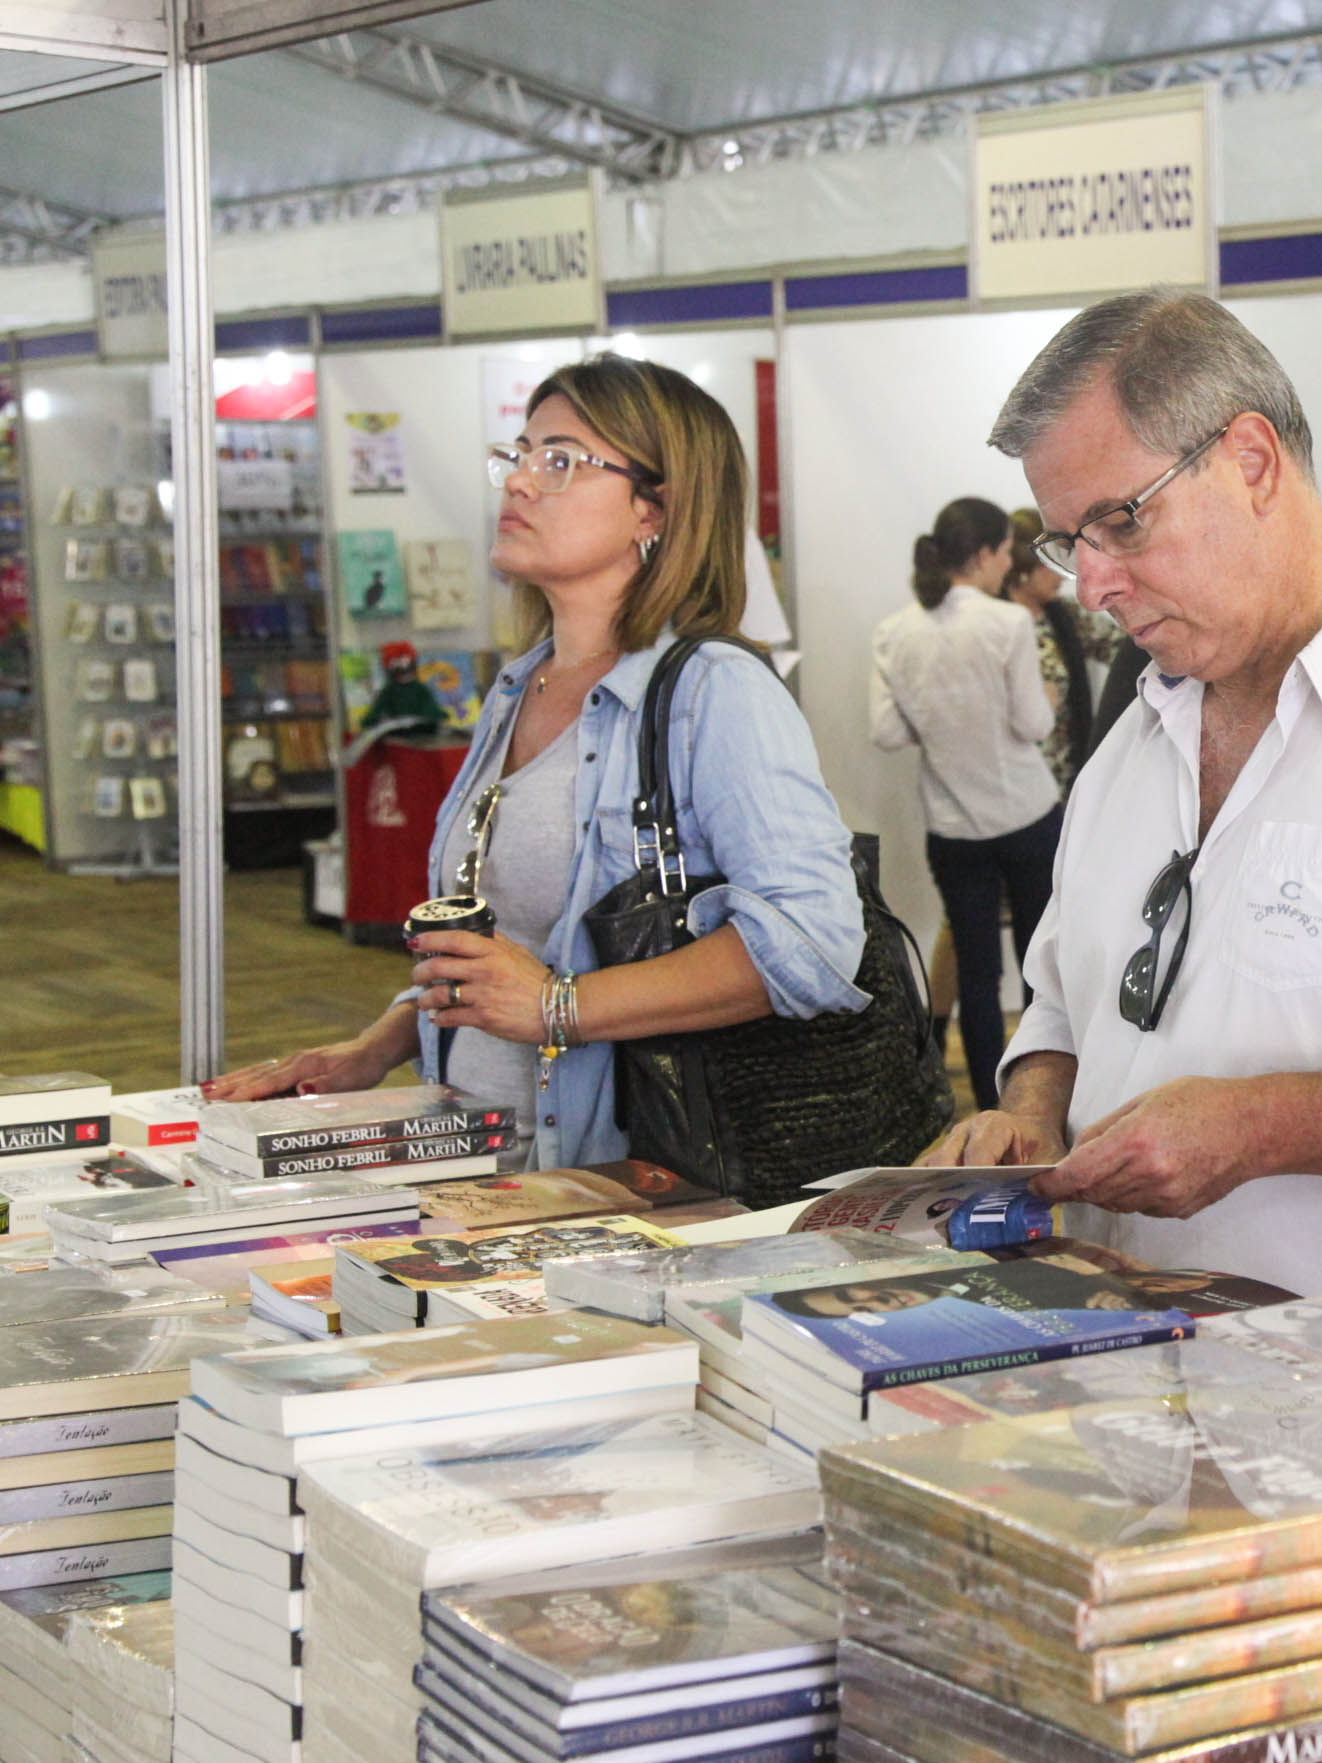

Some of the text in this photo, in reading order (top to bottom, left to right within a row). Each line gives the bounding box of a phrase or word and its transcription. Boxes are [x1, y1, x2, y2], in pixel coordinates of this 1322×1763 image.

[989, 177, 1075, 243] ESCRITORES
[271, 1133, 329, 1151] SONHO
[331, 1126, 386, 1145] FEBRIL
[278, 1157, 336, 1176] SONHO
[337, 1149, 391, 1168] FEBRIL
[900, 1366, 941, 1383] CHAVES
[961, 1351, 1039, 1374] PERSEVERANÇA
